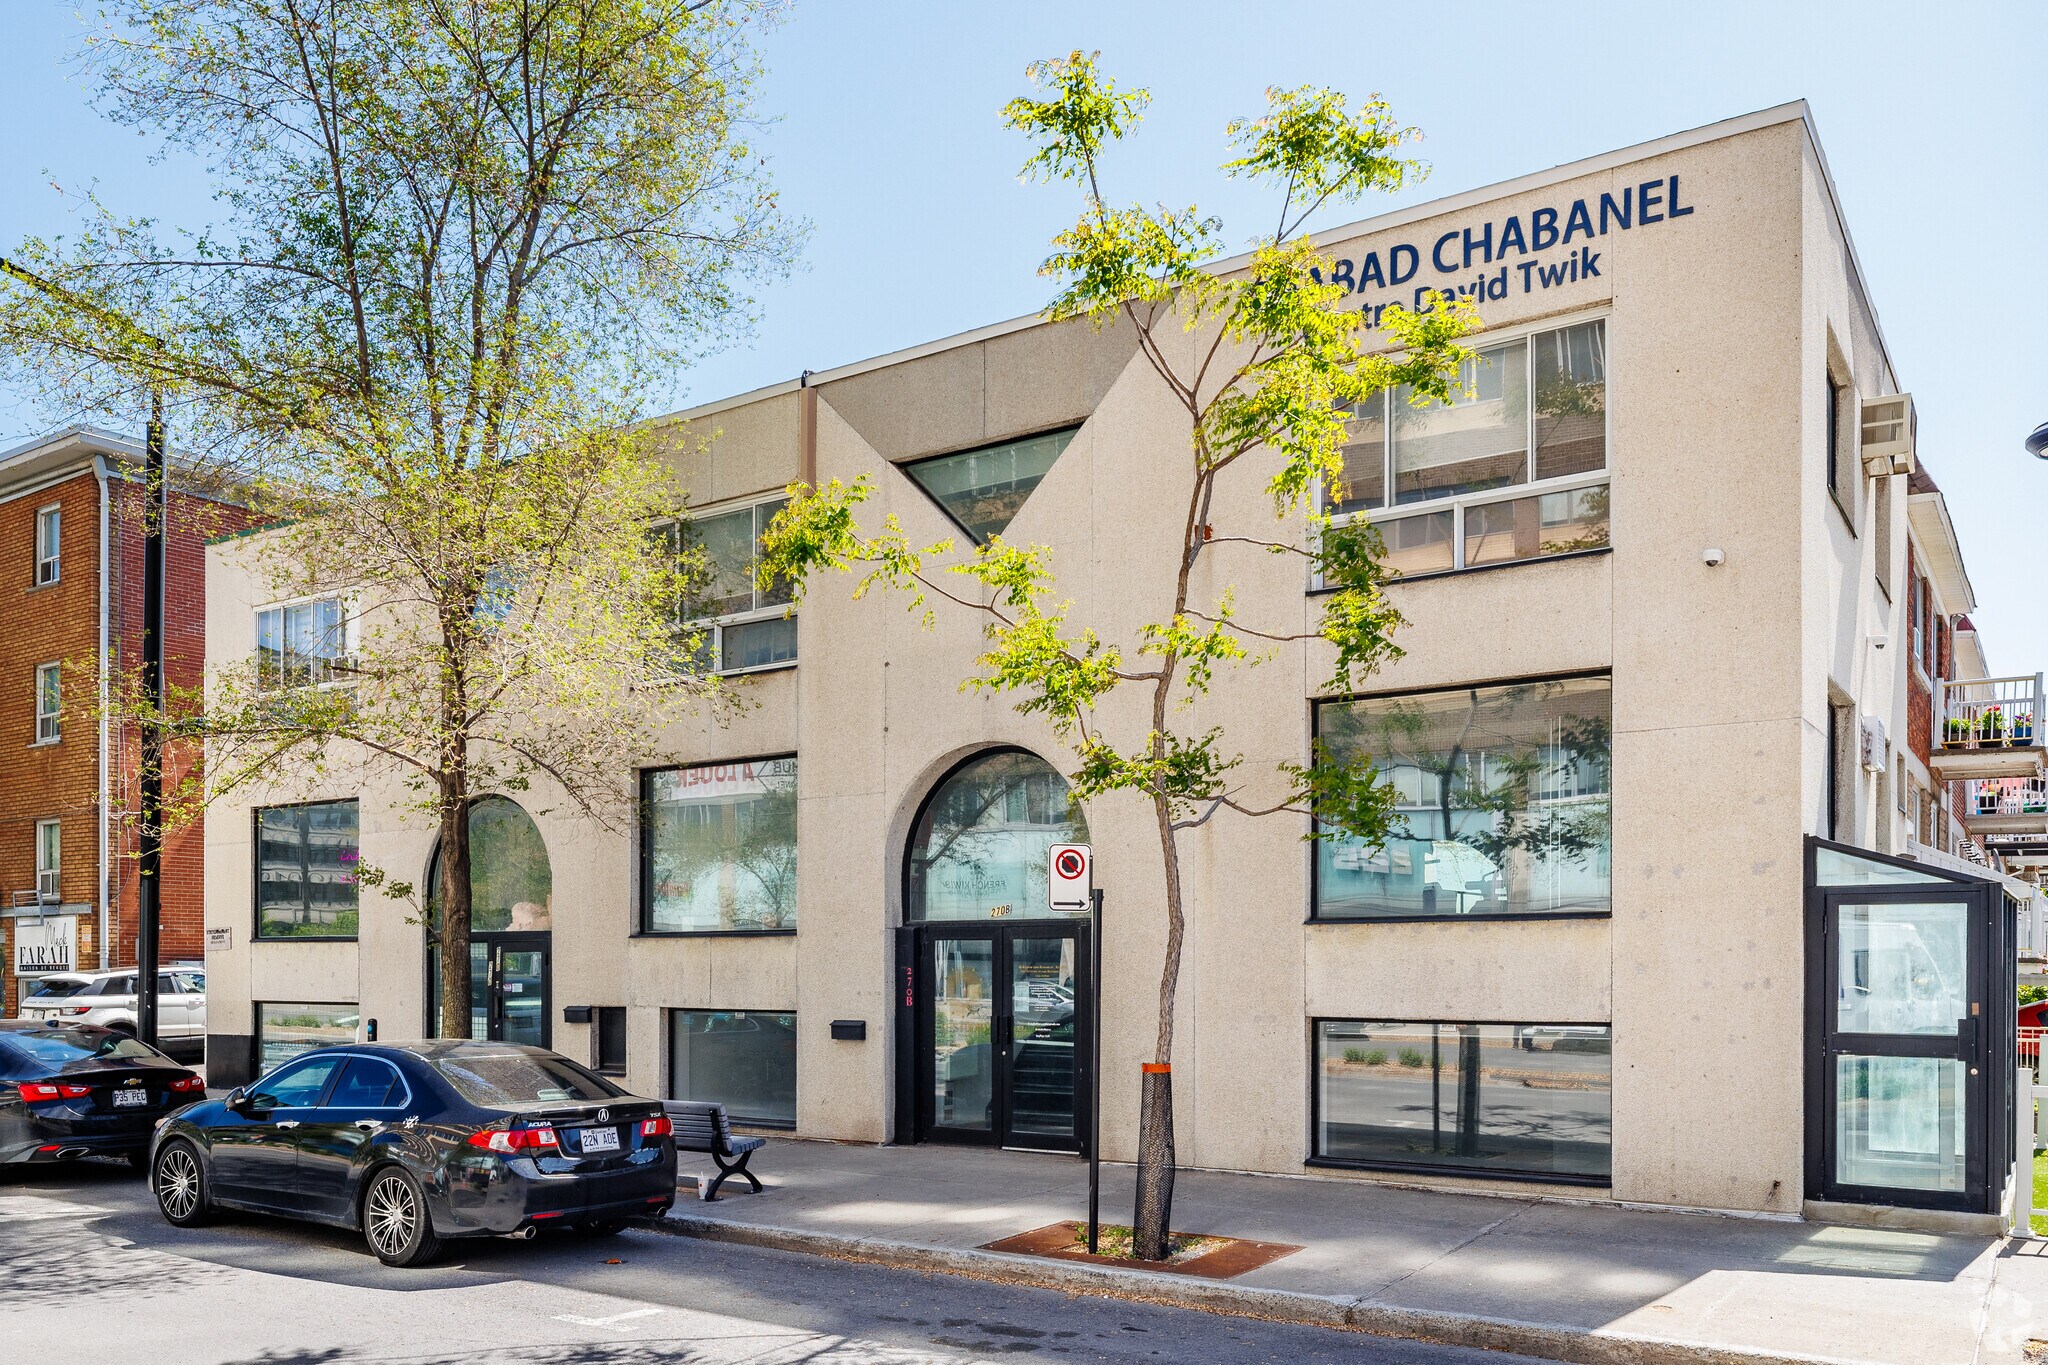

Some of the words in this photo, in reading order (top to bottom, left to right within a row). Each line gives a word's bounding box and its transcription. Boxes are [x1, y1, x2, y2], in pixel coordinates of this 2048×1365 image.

[1432, 174, 1695, 273] CHABANEL
[1516, 245, 1602, 293] Twik
[20, 945, 69, 964] FARAH
[132, 1092, 146, 1101] PEC
[583, 1134, 599, 1147] 22N
